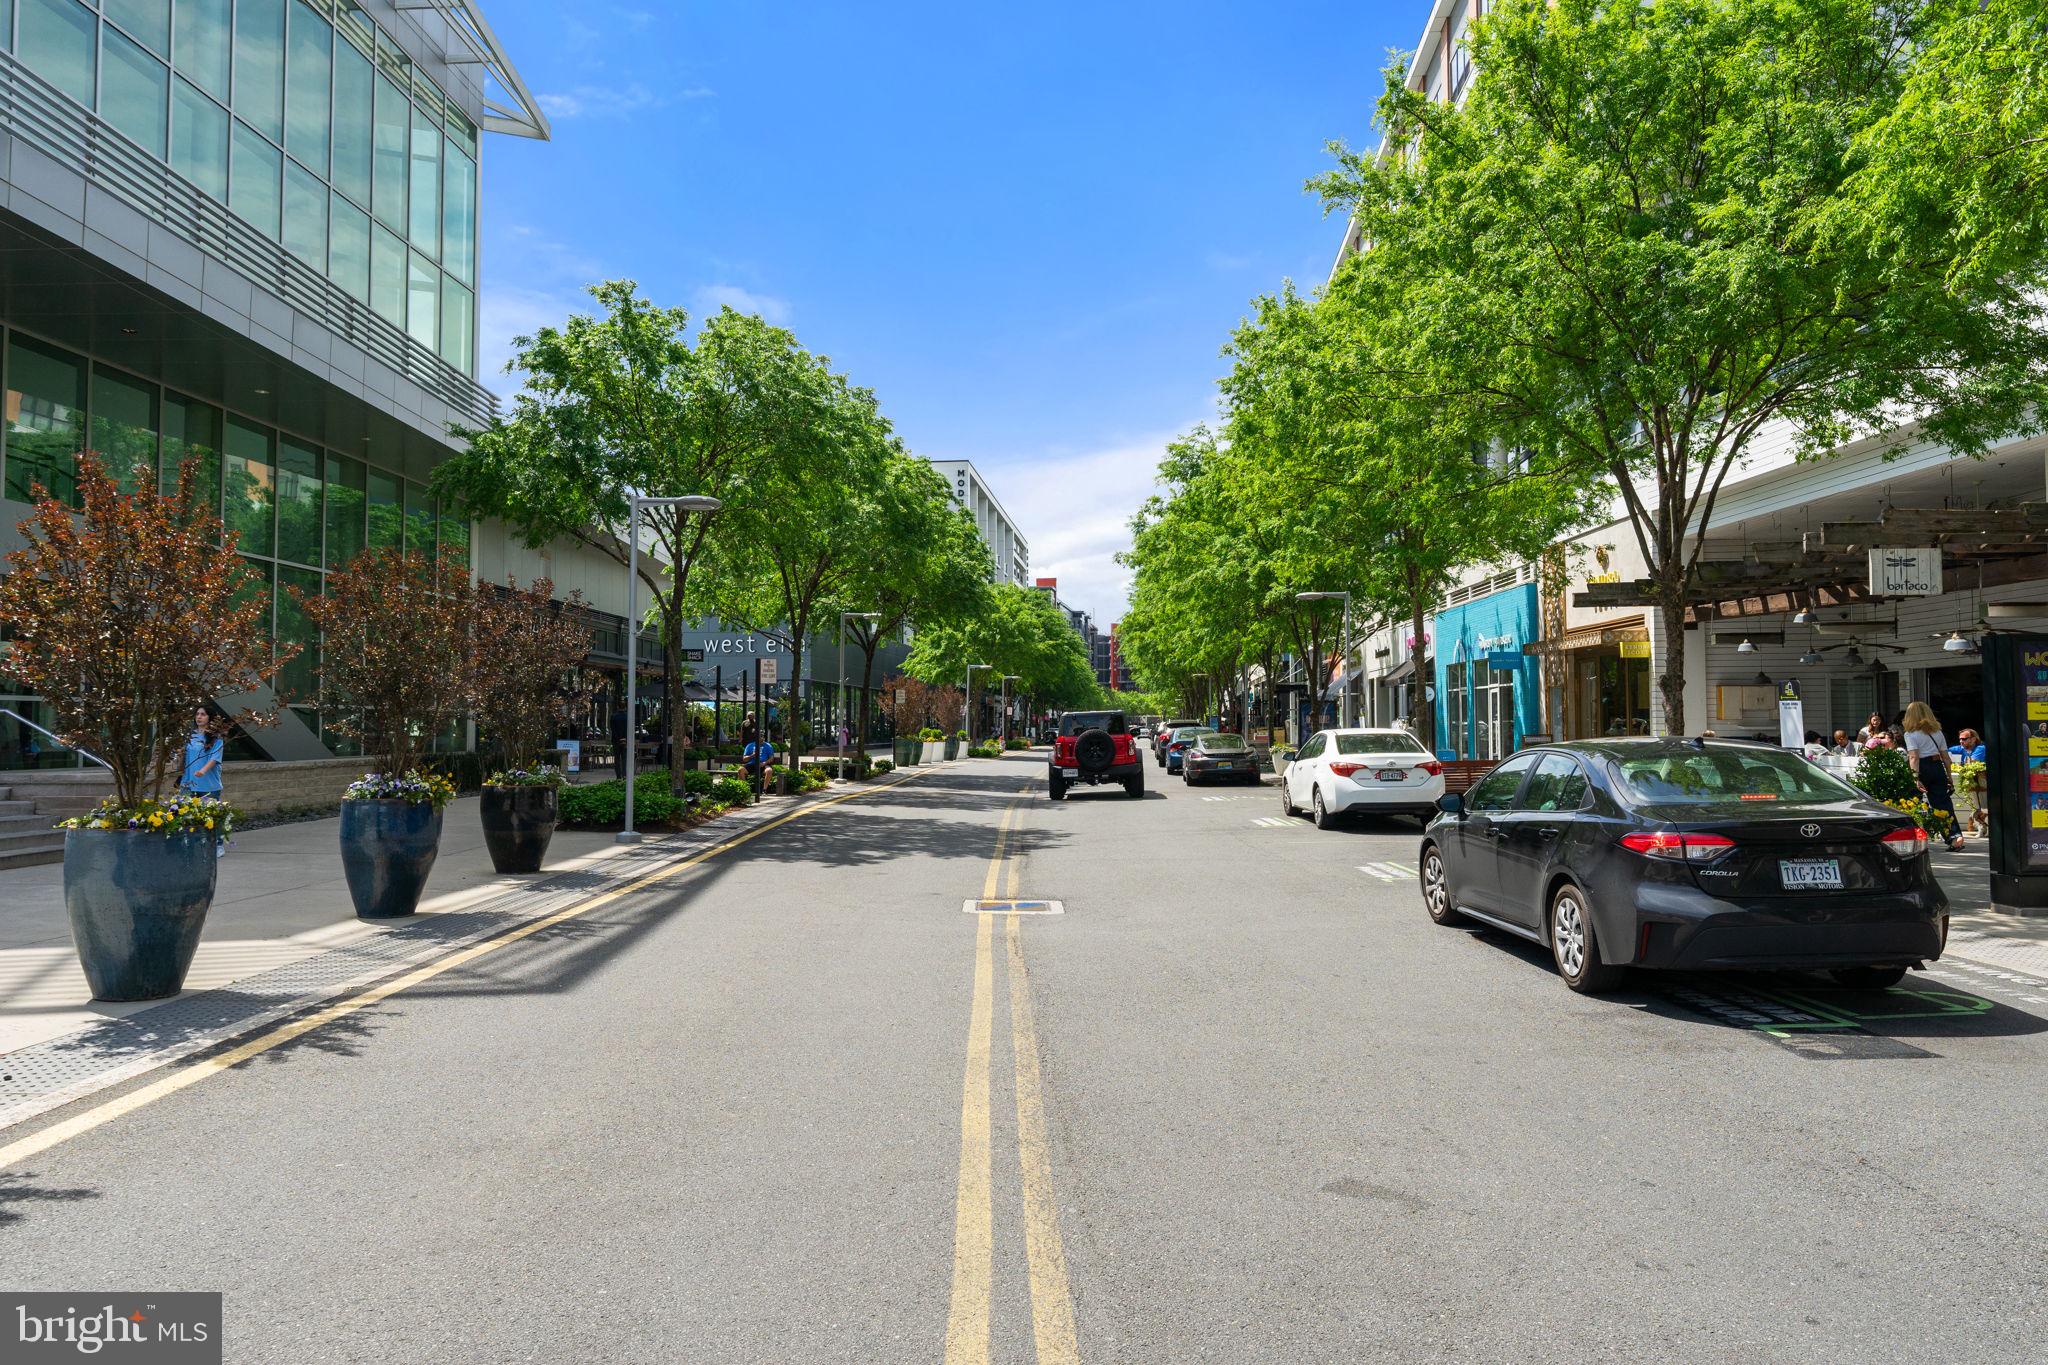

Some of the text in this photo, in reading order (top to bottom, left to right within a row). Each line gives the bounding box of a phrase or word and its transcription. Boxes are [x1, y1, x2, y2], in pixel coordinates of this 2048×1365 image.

[1886, 575, 1928, 591] bartaco
[703, 635, 756, 653] west
[1783, 866, 1839, 881] TKG-2351
